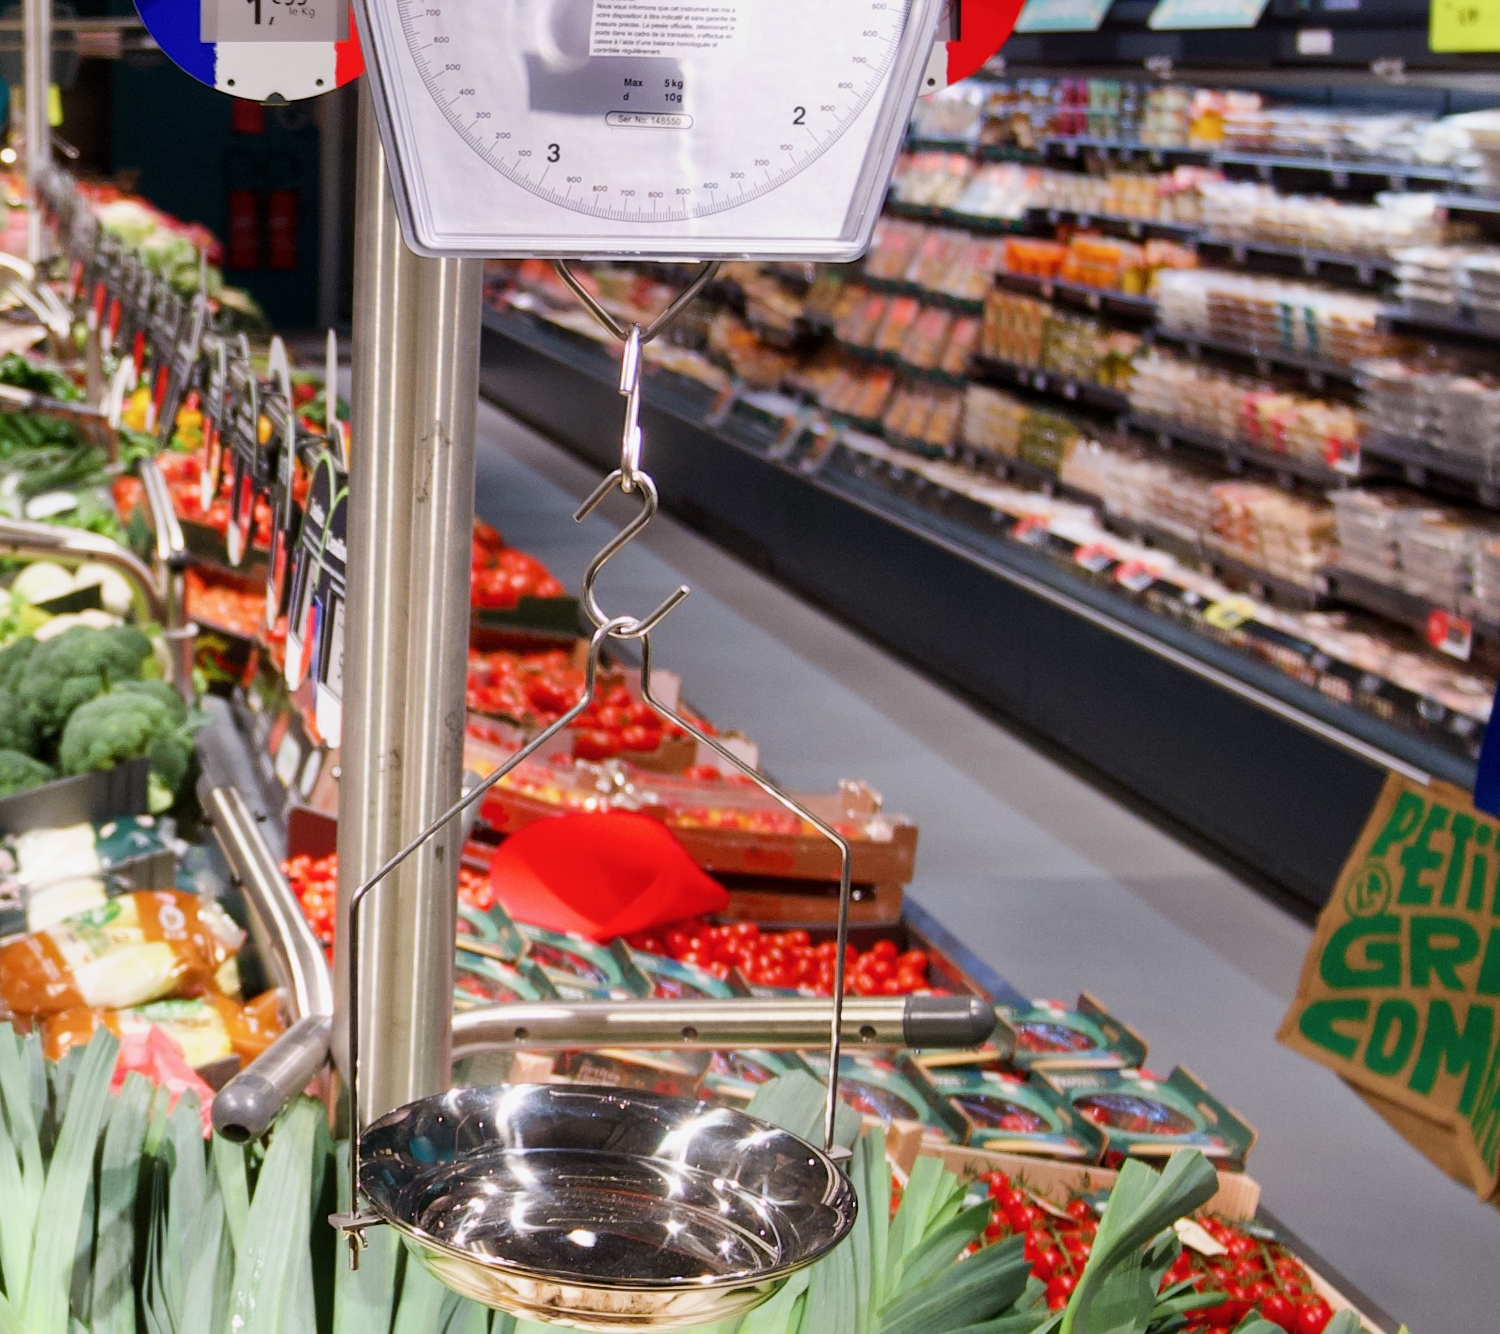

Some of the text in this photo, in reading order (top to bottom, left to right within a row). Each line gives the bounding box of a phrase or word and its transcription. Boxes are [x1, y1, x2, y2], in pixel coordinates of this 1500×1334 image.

[623, 78, 643, 87] Max
[459, 88, 475, 96] 400
[623, 92, 629, 101] d
[792, 106, 806, 125] 2
[546, 143, 561, 163] 3
[620, 189, 635, 197] 700
